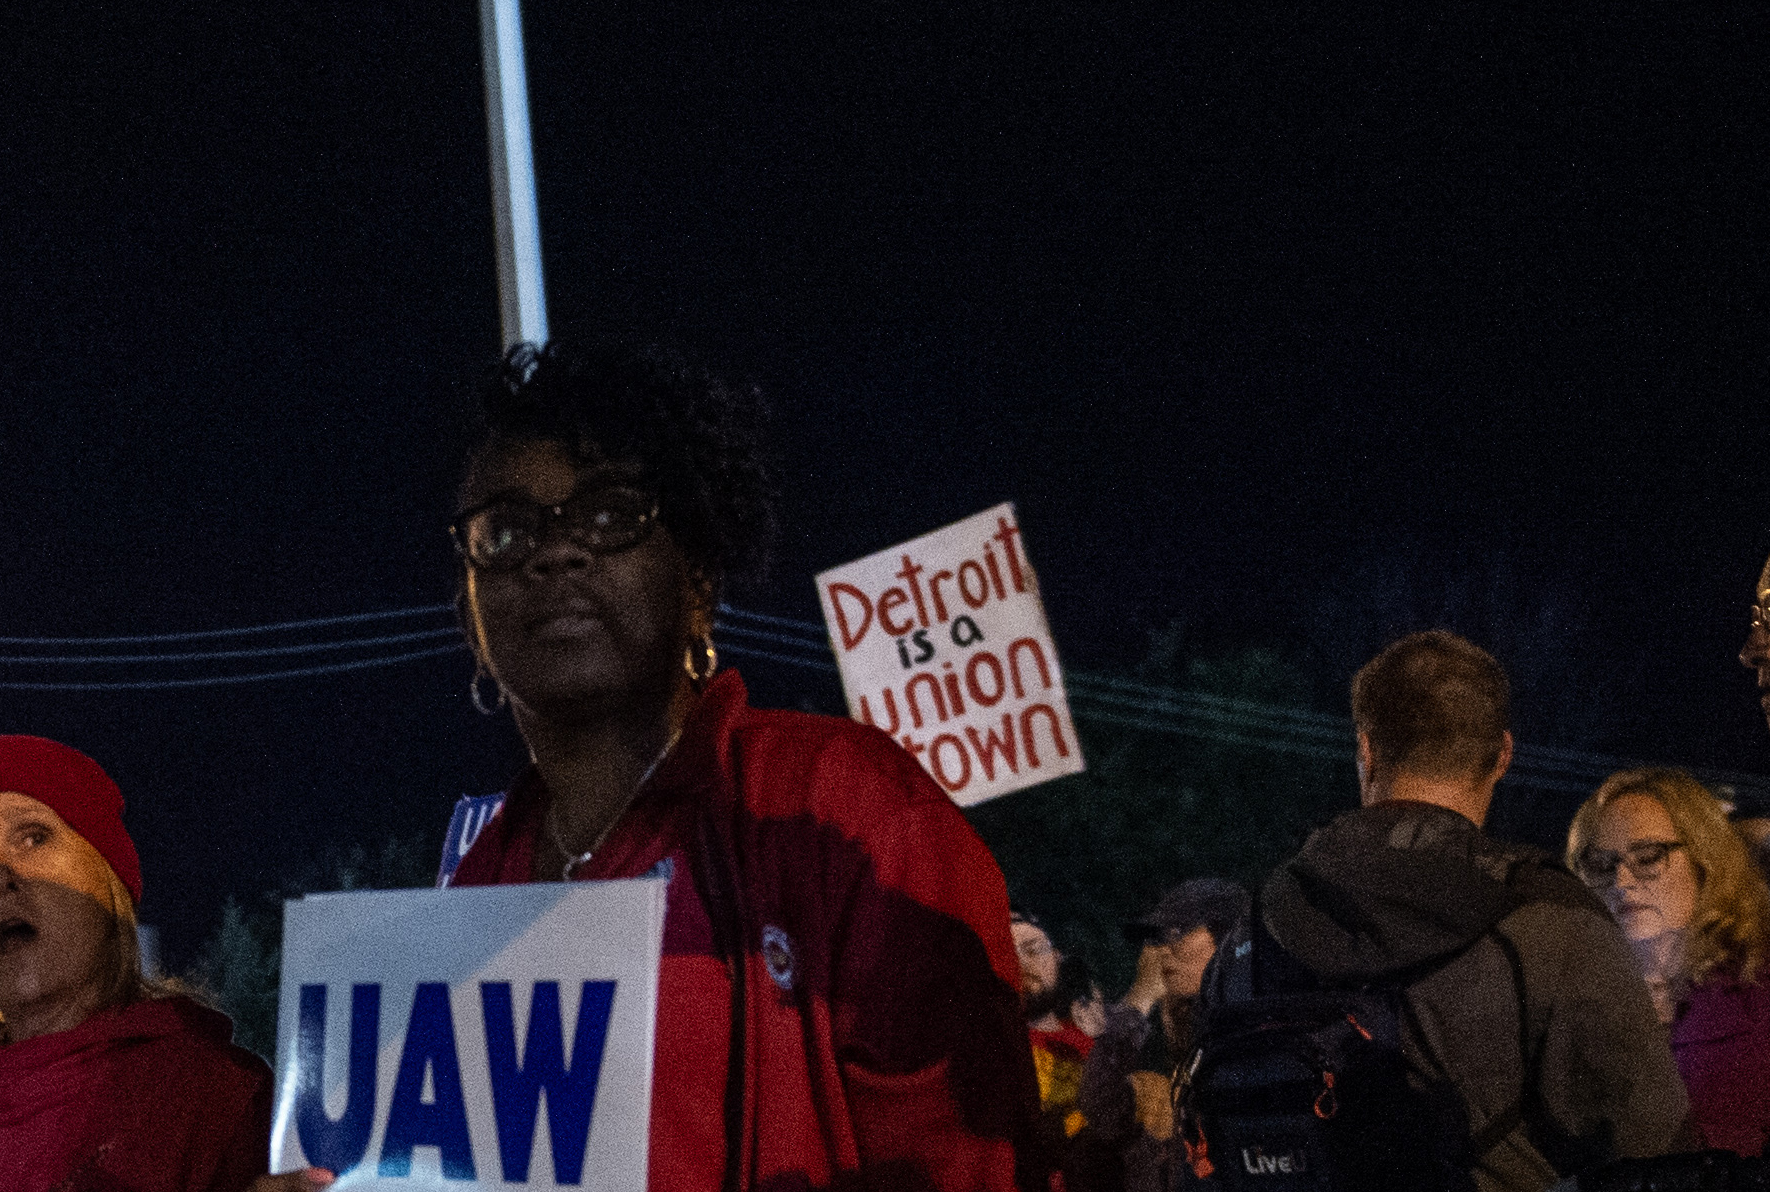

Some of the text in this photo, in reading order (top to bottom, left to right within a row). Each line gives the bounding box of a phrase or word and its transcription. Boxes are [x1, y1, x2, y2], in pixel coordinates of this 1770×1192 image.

[828, 516, 1027, 652] Detroit
[896, 614, 985, 670] is a
[858, 636, 1053, 737] union
[294, 979, 619, 1187] UAW
